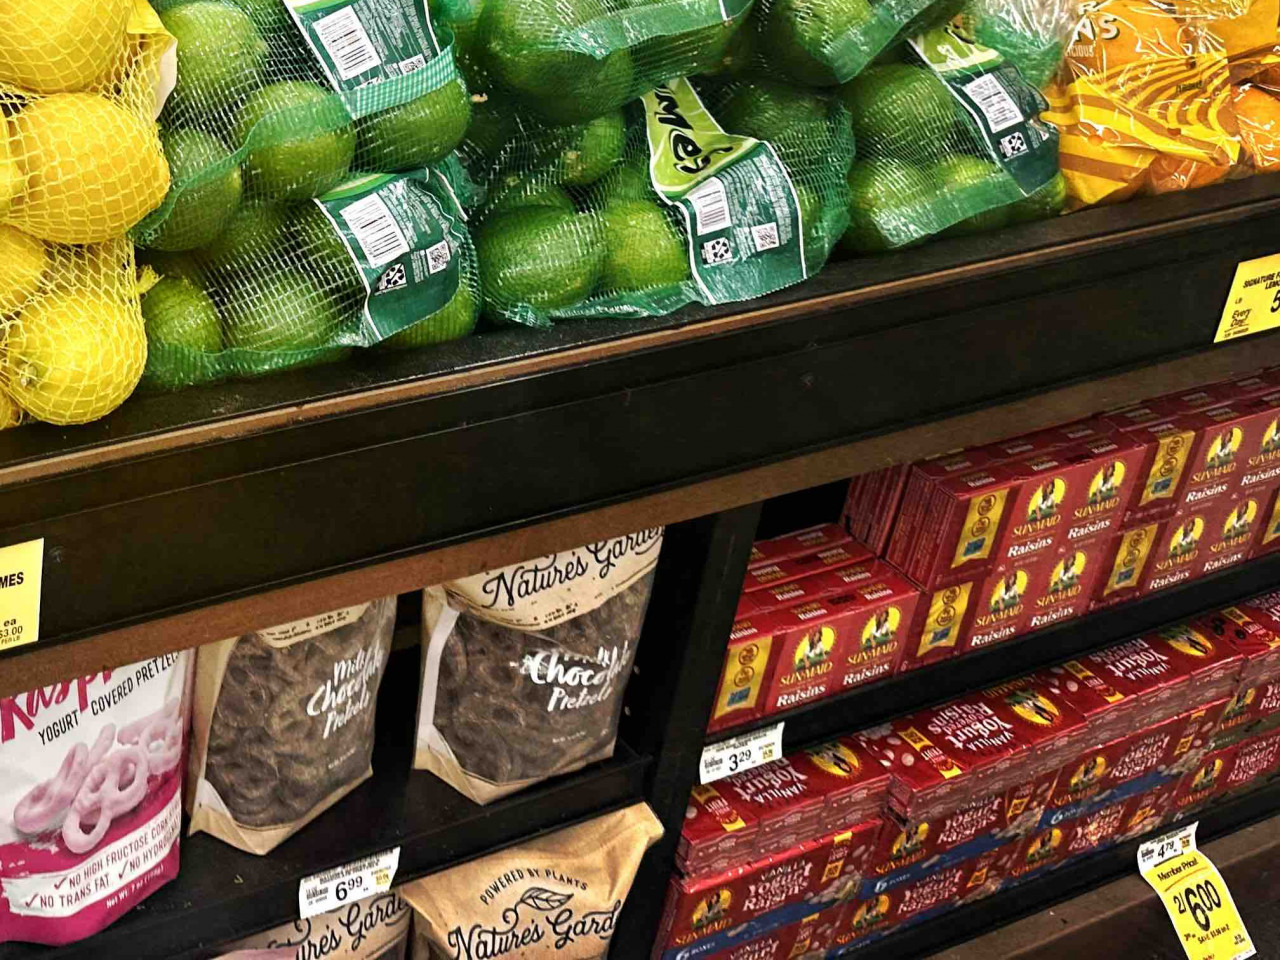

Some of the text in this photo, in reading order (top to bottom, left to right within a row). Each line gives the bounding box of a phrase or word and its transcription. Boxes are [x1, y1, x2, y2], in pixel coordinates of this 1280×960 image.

[1185, 483, 1228, 503] Raisins
[1067, 518, 1112, 540] Raisins
[1007, 536, 1054, 558] Raisins
[1203, 551, 1244, 572] Raisins
[482, 553, 589, 609] Nature's
[1149, 569, 1190, 590] Raisins
[3, 618, 17, 627] ea
[1030, 606, 1074, 627] Raisins
[971, 624, 1016, 647] Raisins
[842, 662, 890, 686] Raisins
[1105, 648, 1169, 678] Yogurt
[1126, 661, 1171, 681] VANILLA
[776, 683, 827, 708] Raisins
[37, 709, 79, 746] YOGURT
[90, 681, 134, 717] COVERED
[927, 702, 994, 735] Raisins
[942, 712, 986, 735] Covered
[945, 715, 1014, 750] Yogurt
[966, 730, 1015, 752] VANILLA
[733, 765, 809, 802] Yogurt
[753, 781, 808, 804] VANILLA
[705, 797, 729, 813] FRUIT
[69, 875, 81, 889] NO
[83, 858, 104, 879] HIGH
[106, 832, 149, 867] FRUCTOSE
[39, 858, 141, 908] NO TRANS FAT NO
[1157, 864, 1183, 881] Member
[479, 867, 589, 905] POWERED BY PLANTS
